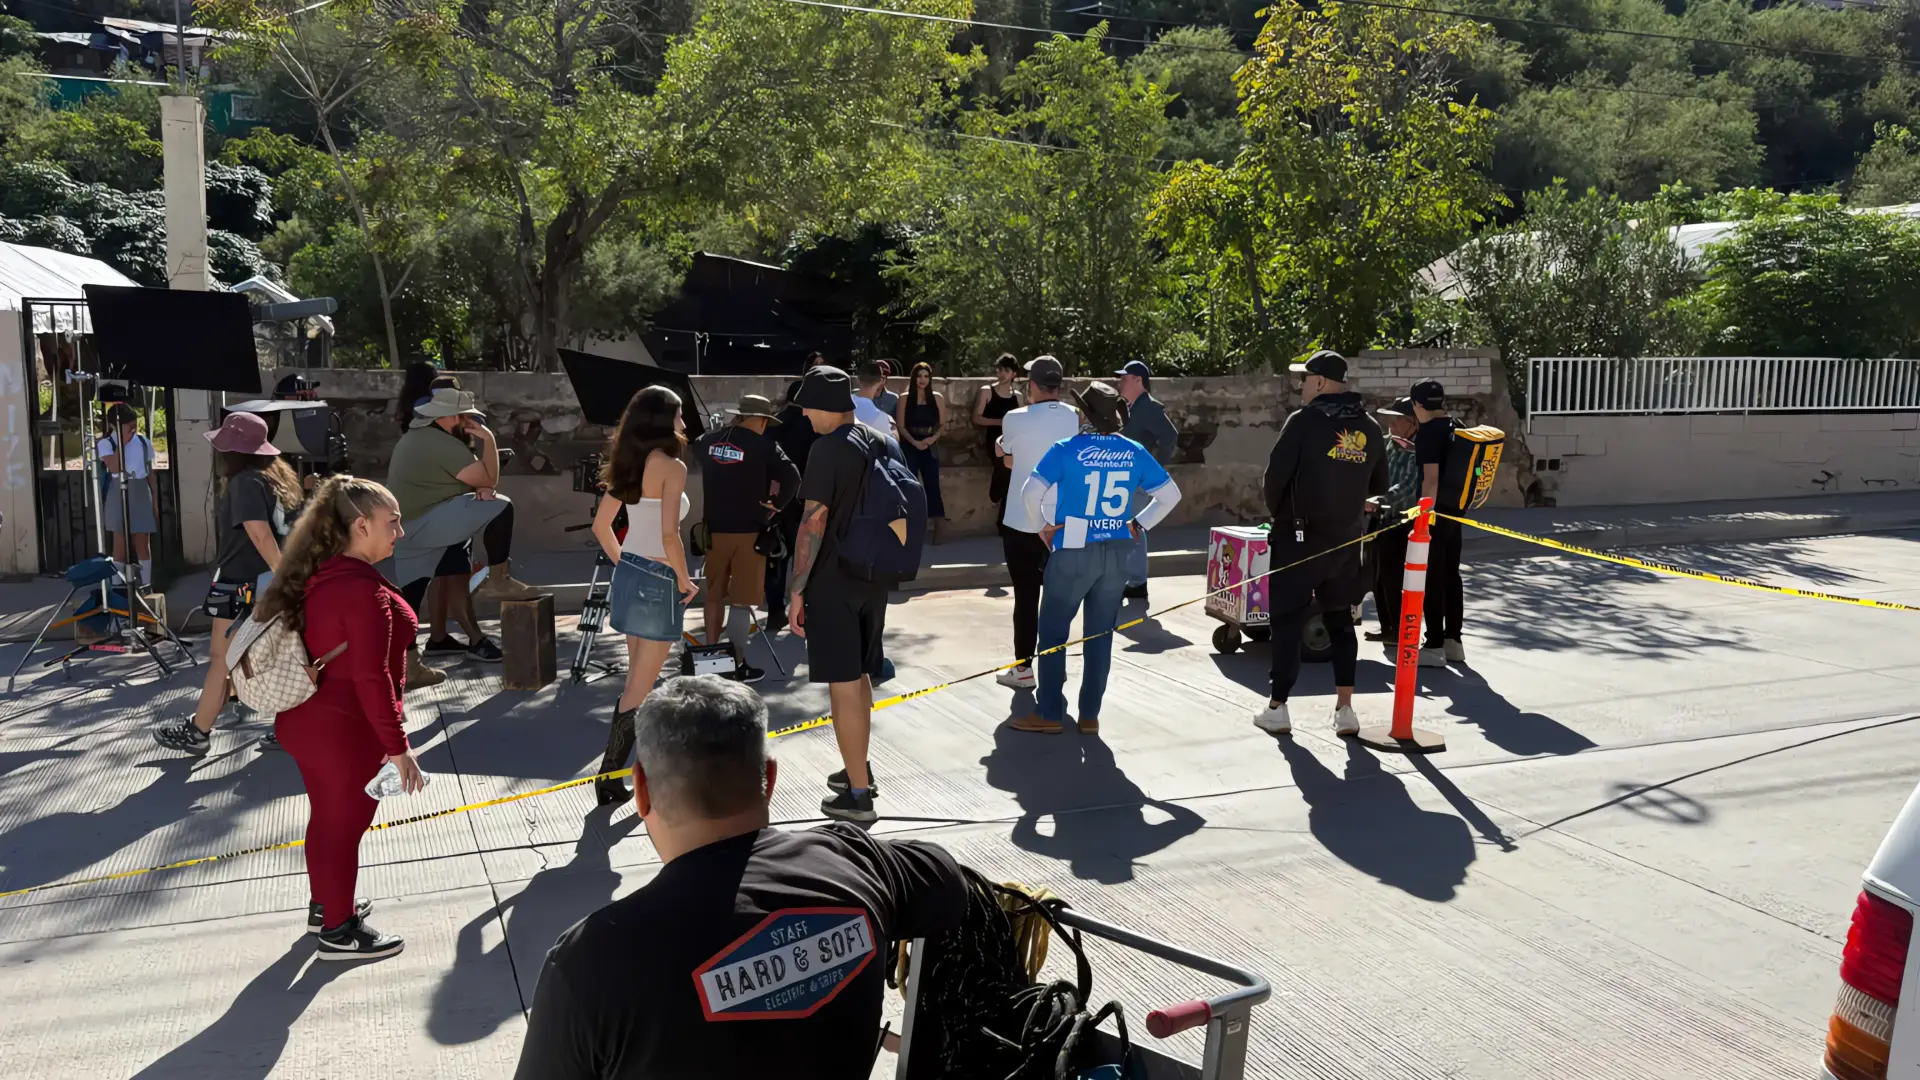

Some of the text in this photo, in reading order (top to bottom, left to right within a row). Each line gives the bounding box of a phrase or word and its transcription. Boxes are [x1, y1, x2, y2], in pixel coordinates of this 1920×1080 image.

[1084, 470, 1130, 518] 15
[770, 920, 809, 946] STAFF
[714, 922, 865, 1001] HARD & SOFT
[764, 984, 805, 1011] ELECTRIC
